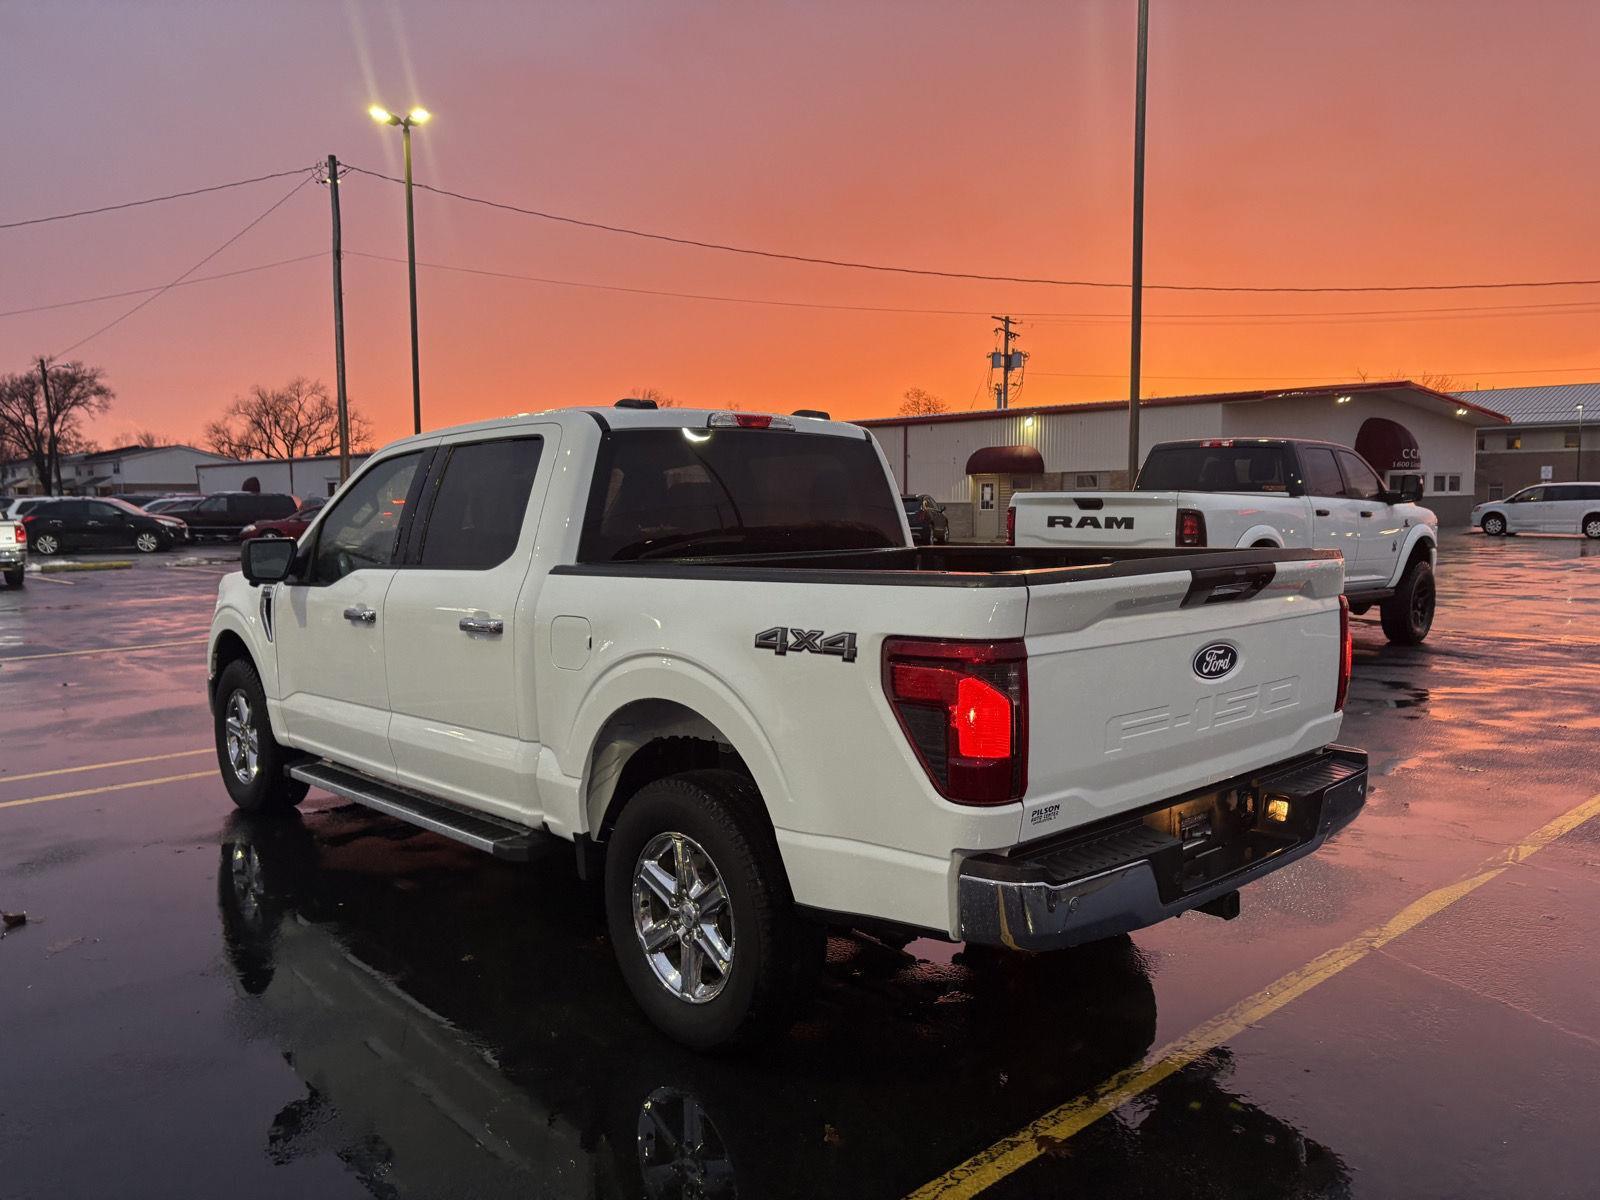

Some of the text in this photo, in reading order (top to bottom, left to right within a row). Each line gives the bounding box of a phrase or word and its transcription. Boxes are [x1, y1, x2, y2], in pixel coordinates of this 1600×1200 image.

[1047, 515, 1135, 530] RAM
[1202, 649, 1231, 674] Ford
[1104, 675, 1301, 755] F-150
[1031, 804, 1060, 817] PILSON
